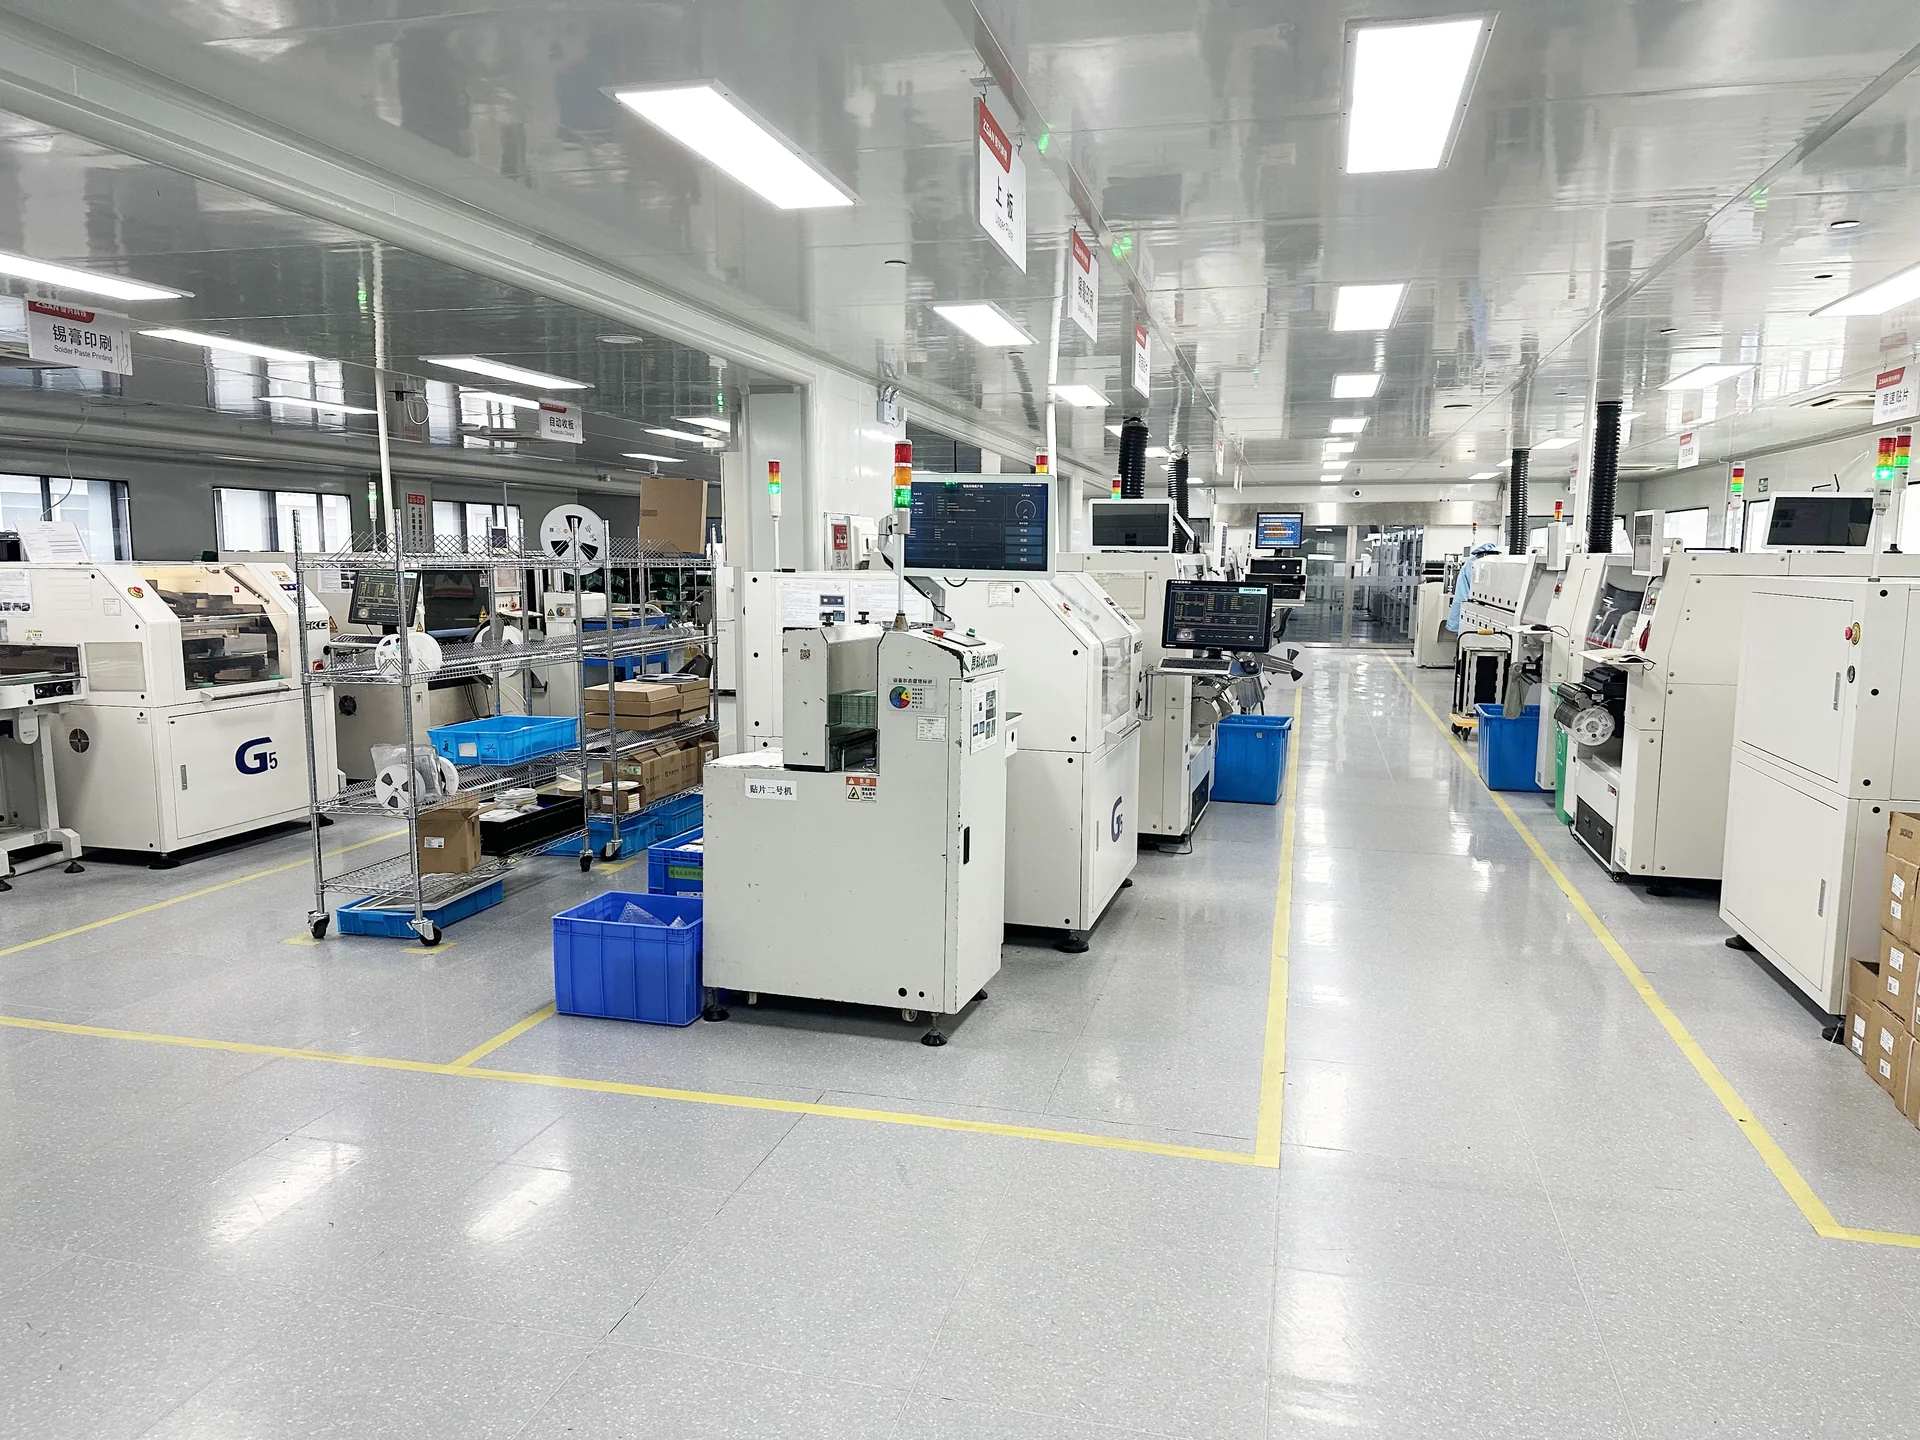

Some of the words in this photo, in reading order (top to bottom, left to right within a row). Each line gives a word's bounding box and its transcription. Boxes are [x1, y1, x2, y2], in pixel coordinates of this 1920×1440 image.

[995, 176, 1014, 222] 上板
[52, 323, 112, 351] 锡膏印刷
[53, 344, 73, 355] Solder
[74, 349, 91, 358] Paste
[92, 352, 113, 363] Printing
[1882, 388, 1909, 407] 高速贴片
[549, 416, 574, 430] 自动收板
[235, 736, 278, 775] G5
[749, 784, 793, 796] 贴片二号机
